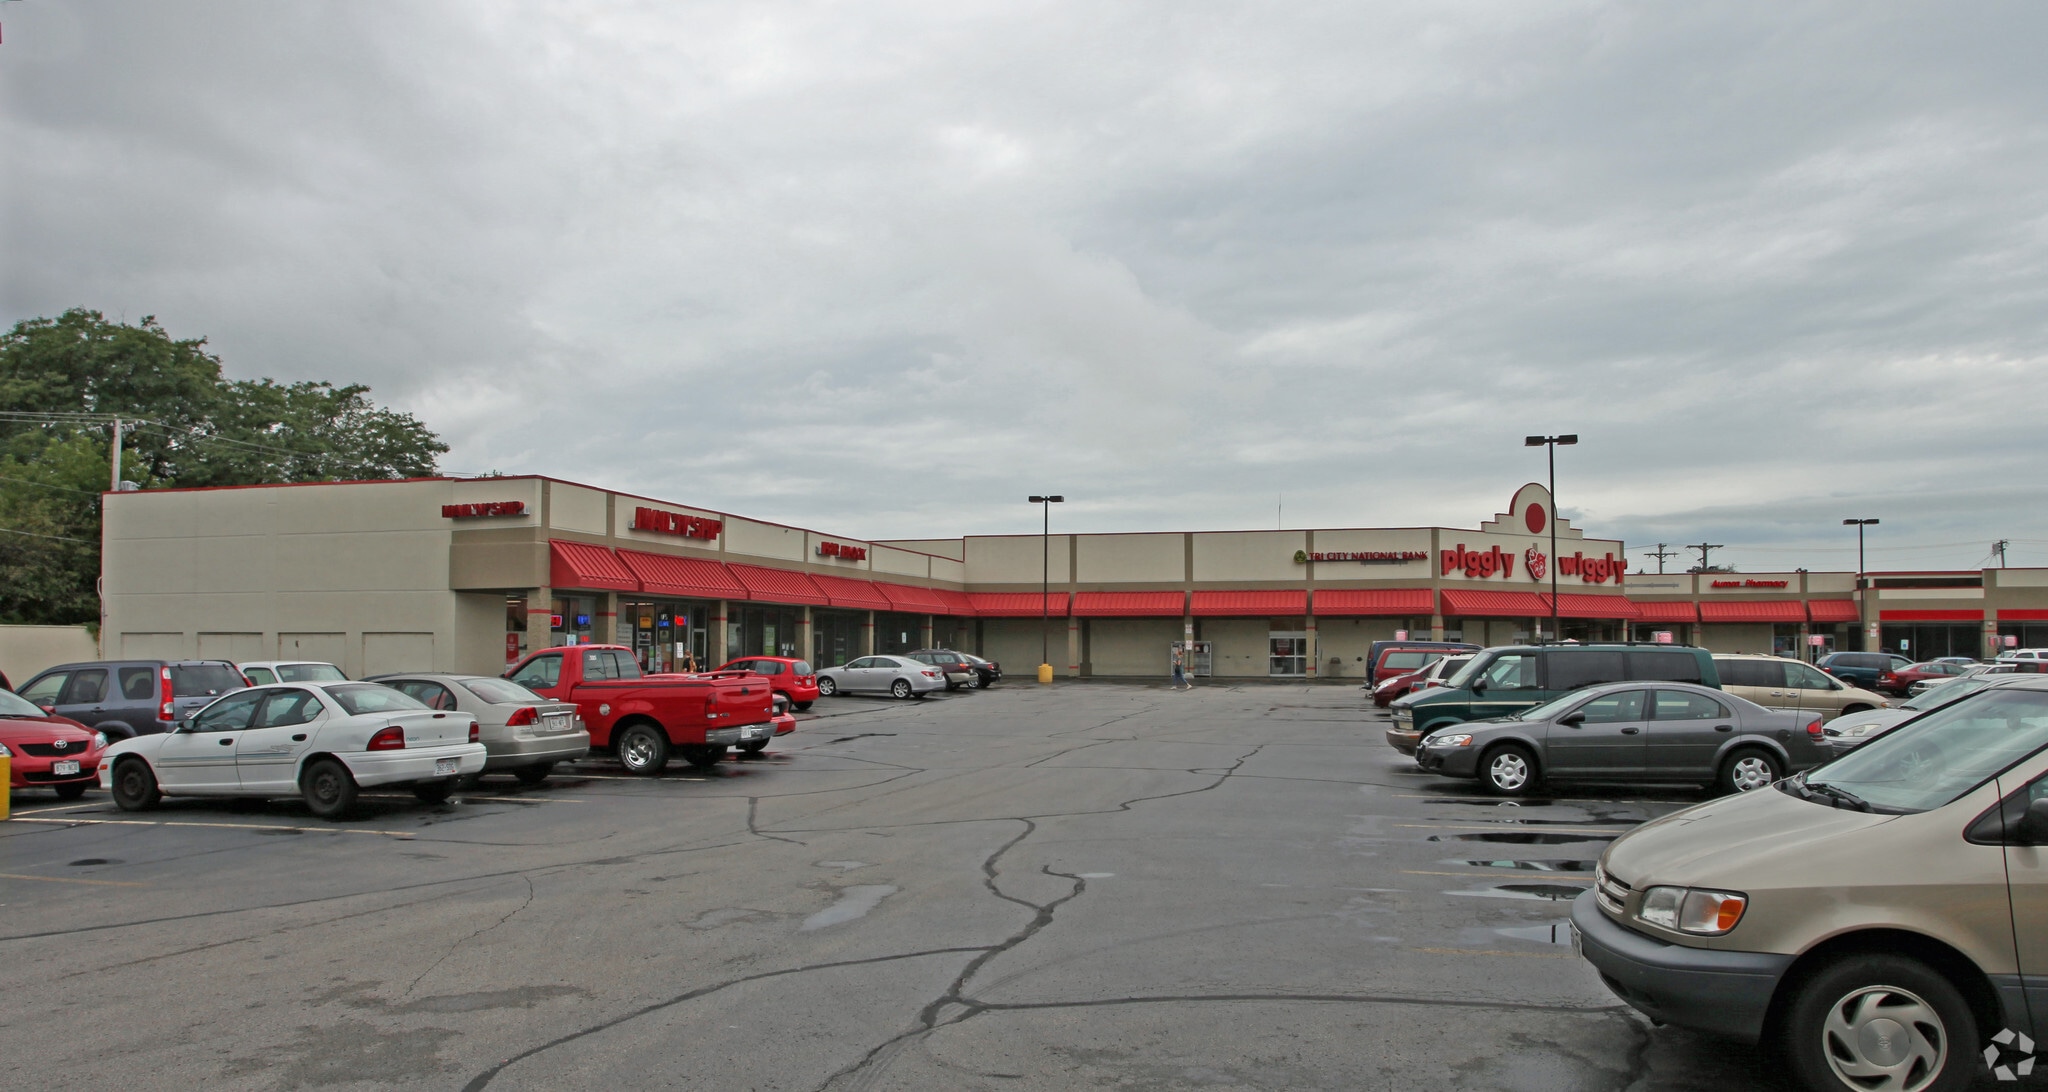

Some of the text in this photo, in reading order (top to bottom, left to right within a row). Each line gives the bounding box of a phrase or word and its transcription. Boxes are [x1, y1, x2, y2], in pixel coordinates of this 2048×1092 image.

[1309, 551, 1428, 560] TRI CITY NATIONAL BANK
[1441, 543, 1625, 584] piggly wiggly
[1745, 579, 1789, 589] Pharmacy
